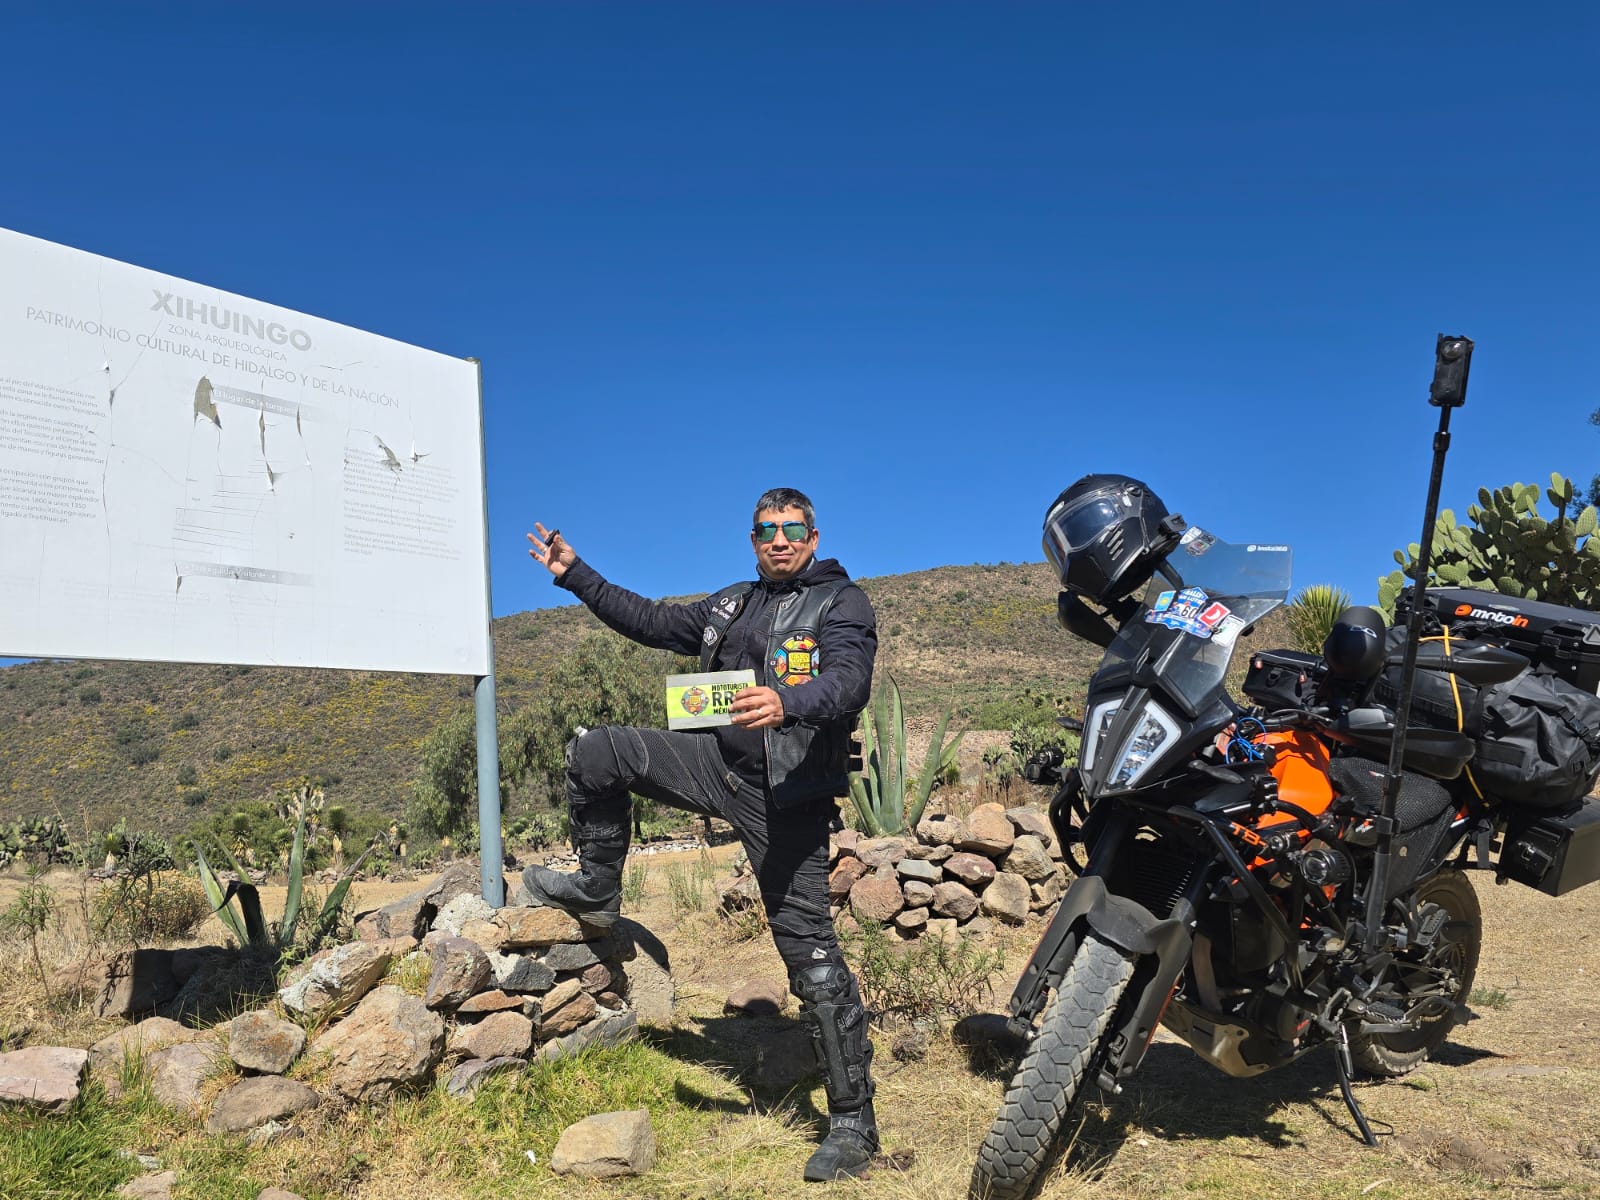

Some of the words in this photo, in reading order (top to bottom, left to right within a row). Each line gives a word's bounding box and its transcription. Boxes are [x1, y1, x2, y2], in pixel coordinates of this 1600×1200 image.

[150, 288, 313, 352] XIHUINGO
[168, 323, 202, 341] ZONA
[26, 306, 131, 343] PATRIMONIO
[136, 333, 208, 362] CULTURAL
[212, 352, 230, 368] DE
[235, 358, 297, 383] HIDALGO
[300, 374, 309, 386] Y
[312, 377, 328, 391] DE
[332, 382, 346, 396] LA
[350, 387, 399, 409] NACIÓN
[1470, 608, 1530, 628] motoin
[711, 682, 749, 692] MOTOTURISTA
[712, 691, 743, 707] RR
